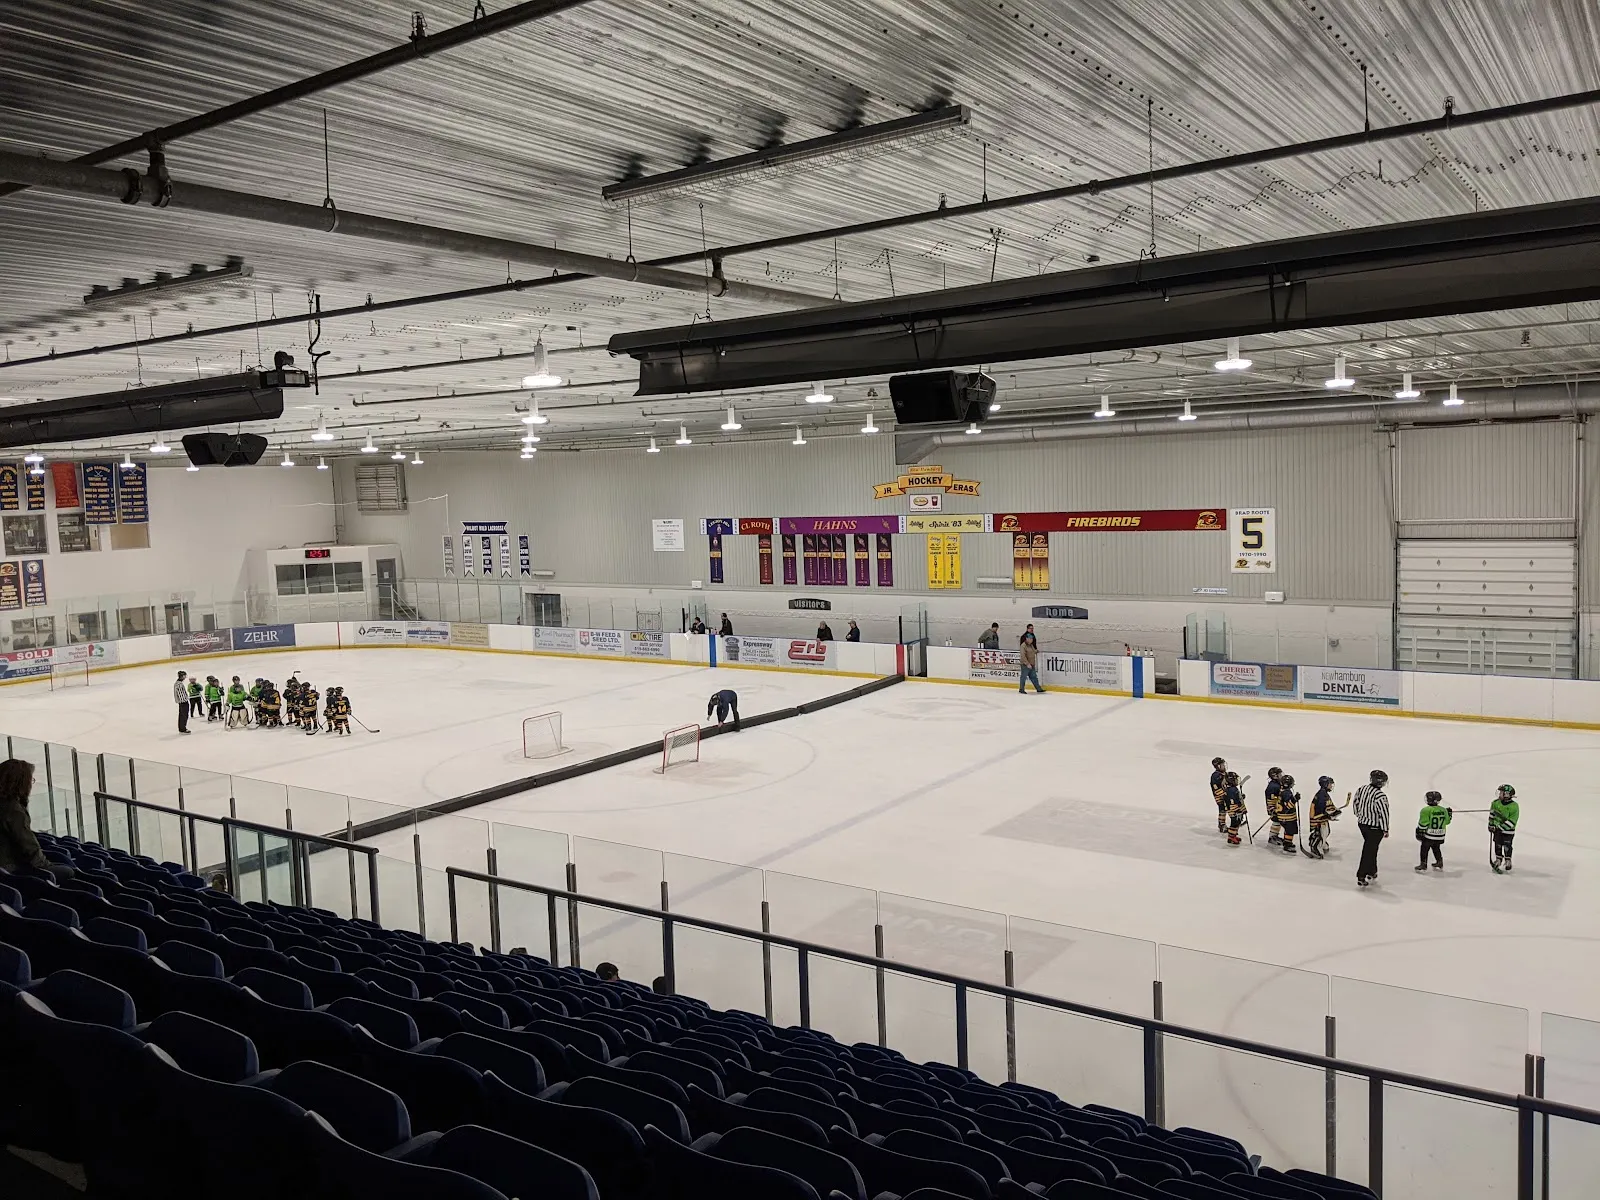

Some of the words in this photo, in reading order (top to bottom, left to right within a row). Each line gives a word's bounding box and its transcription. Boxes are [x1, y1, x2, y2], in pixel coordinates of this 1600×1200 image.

[908, 476, 943, 486] HOCKEY
[883, 487, 892, 495] JR
[953, 484, 974, 492] ERAS
[751, 521, 771, 531] ROTH
[813, 520, 857, 530] HAHNS
[1067, 517, 1141, 527] FIREBIRDS
[1242, 518, 1262, 548] 5
[1046, 607, 1074, 616] home
[244, 630, 278, 642] ZEHR
[16, 649, 50, 660] SOLD
[1323, 682, 1366, 694] DENTAL
[1432, 816, 1445, 830] 87
